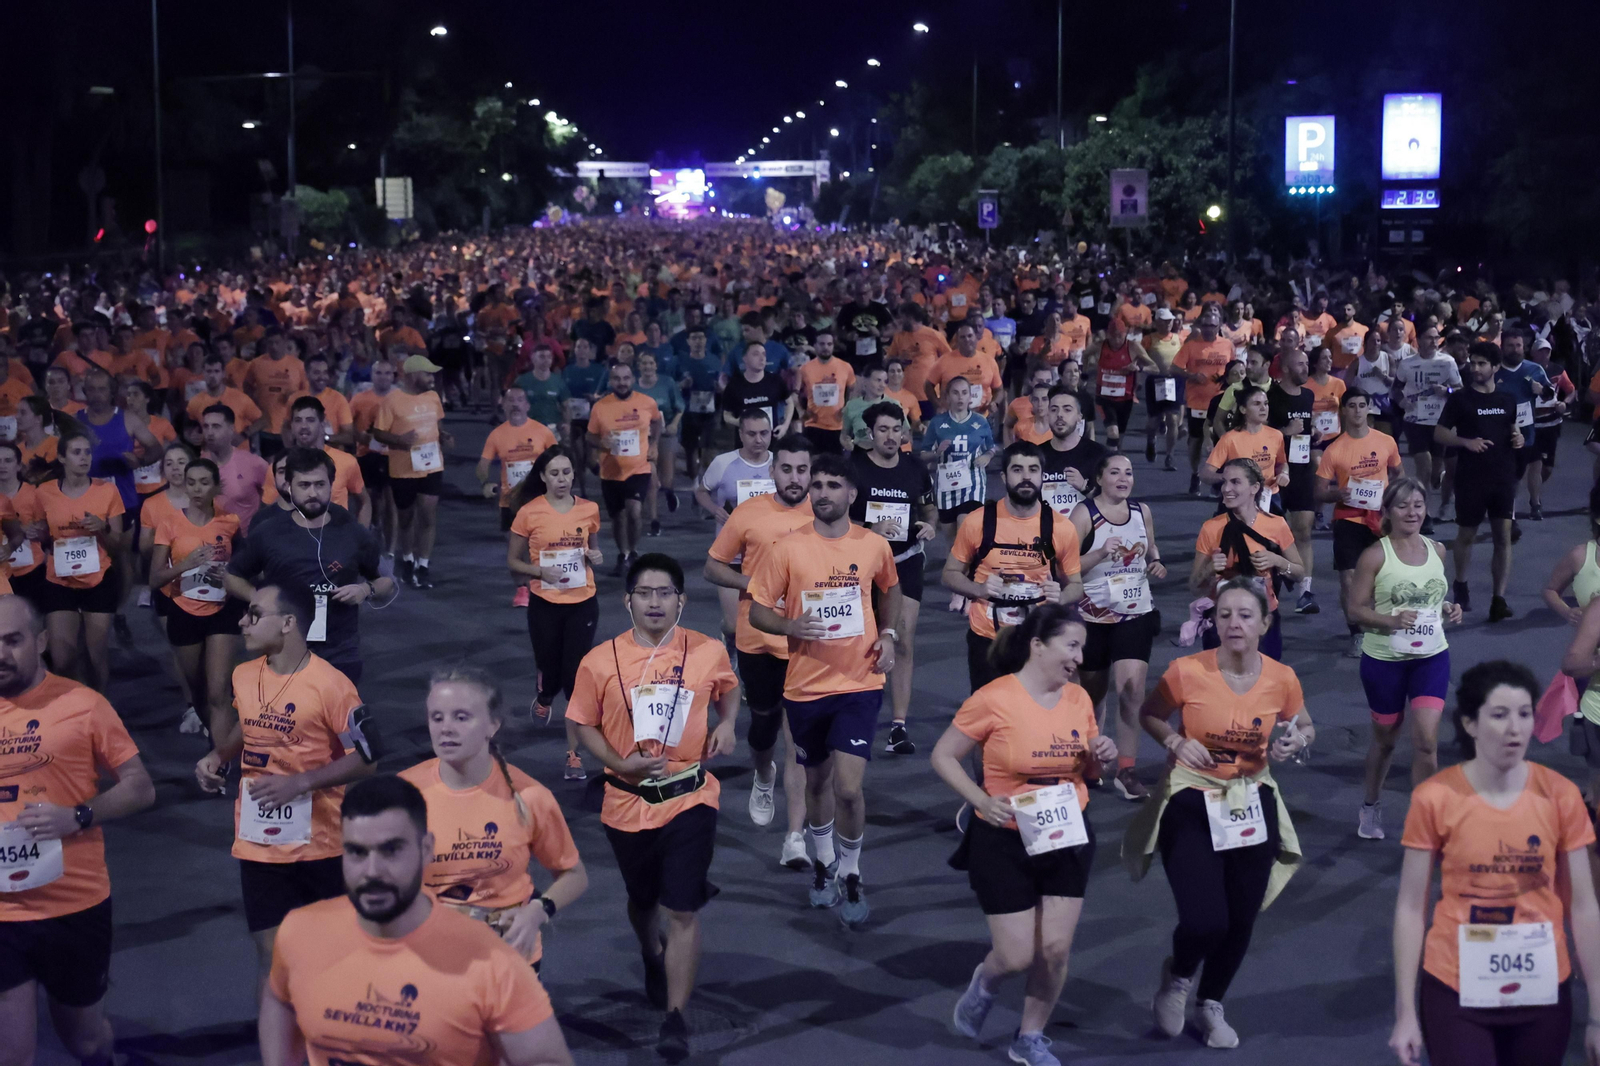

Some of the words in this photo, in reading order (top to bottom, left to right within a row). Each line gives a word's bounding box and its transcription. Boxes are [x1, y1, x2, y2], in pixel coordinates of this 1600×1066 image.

[1298, 122, 1326, 161] P
[1294, 173, 1321, 185] saba
[983, 203, 993, 216] P
[952, 434, 968, 452] fi
[1052, 494, 1078, 504] 18301
[1355, 488, 1377, 498] 16591
[64, 549, 87, 561] 7580
[1000, 549, 1026, 557] SEVILLA
[1123, 587, 1142, 599] 9375
[816, 604, 853, 619] 15042
[244, 718, 273, 730] SEVILLA
[258, 712, 297, 727] NOCTURNA
[0, 735, 42, 746] OCTURNA
[1031, 750, 1068, 758] SEVILLA
[258, 805, 293, 820] 5210
[1037, 806, 1068, 826] 5810
[451, 840, 503, 851] NOCTURNA
[431, 851, 475, 863] SEVILLA
[1469, 864, 1516, 873] SEVILLA
[1489, 952, 1535, 974] 5045
[355, 1001, 421, 1021] NOCTURNA
[323, 1008, 382, 1029] SEVILLA
